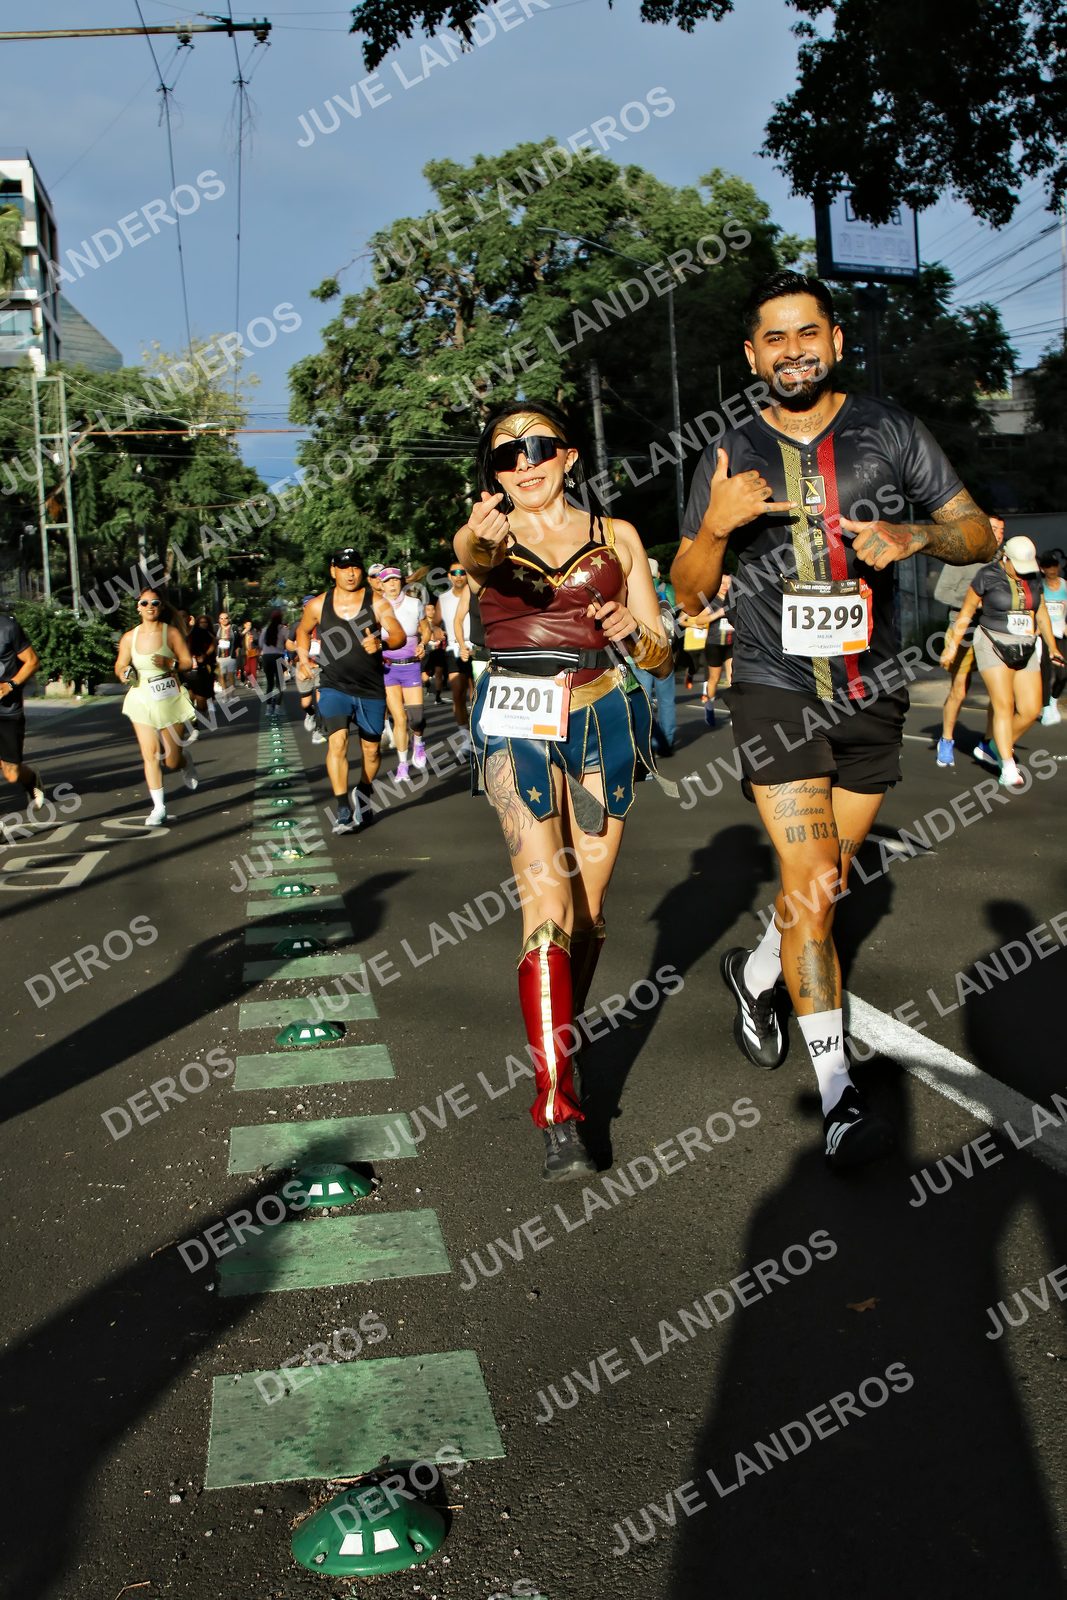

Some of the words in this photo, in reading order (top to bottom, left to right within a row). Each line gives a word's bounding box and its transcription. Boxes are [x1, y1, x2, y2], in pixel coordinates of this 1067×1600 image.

[788, 604, 863, 630] 13299
[151, 680, 176, 692] 10240
[489, 685, 554, 713] 12201
[809, 1036, 839, 1058] BH
